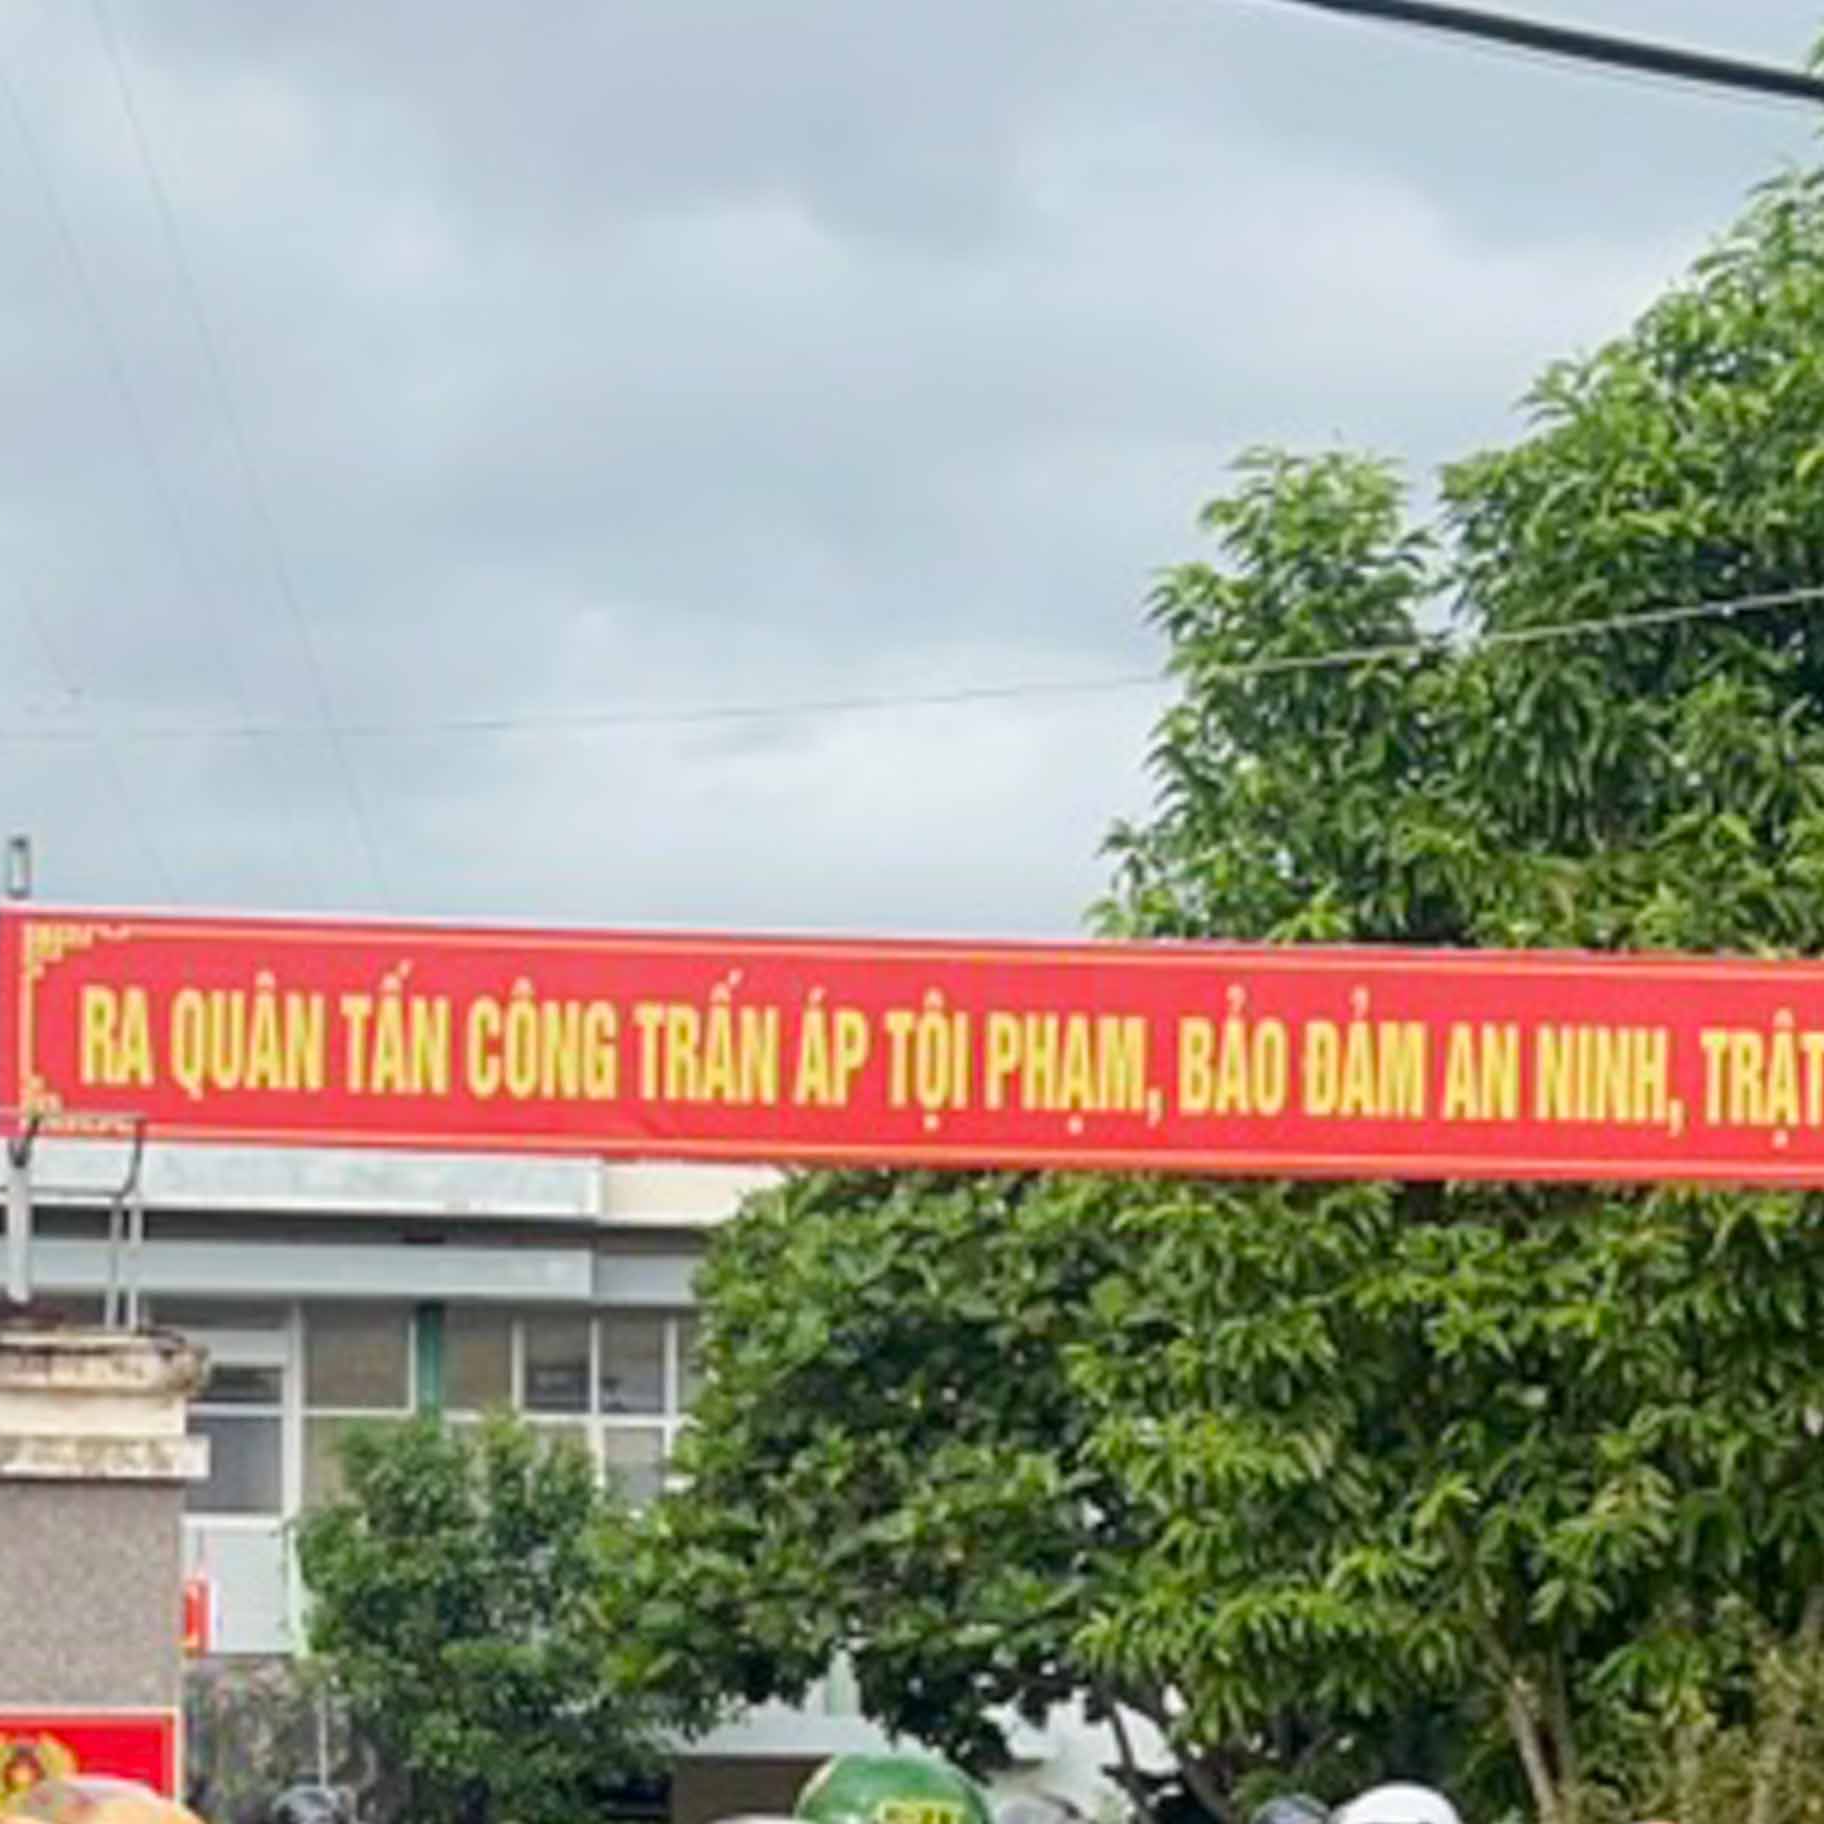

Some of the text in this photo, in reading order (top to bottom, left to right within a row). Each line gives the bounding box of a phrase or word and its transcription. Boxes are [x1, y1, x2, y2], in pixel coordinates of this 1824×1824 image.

[80, 984, 154, 1086] RA
[171, 970, 325, 1100] QUÂN
[340, 960, 451, 1094] TẤN
[466, 977, 618, 1100] CÔNG
[634, 970, 776, 1104] TRẤN
[795, 986, 869, 1107] ÁP
[884, 987, 970, 1131] TỘI
[985, 1012, 1163, 1134] PHẠM,
[1178, 984, 1288, 1116] BẢO
[1302, 987, 1428, 1118] ĐẢM
[1442, 1022, 1519, 1122] AN
[1534, 1024, 1686, 1138] NINH,
